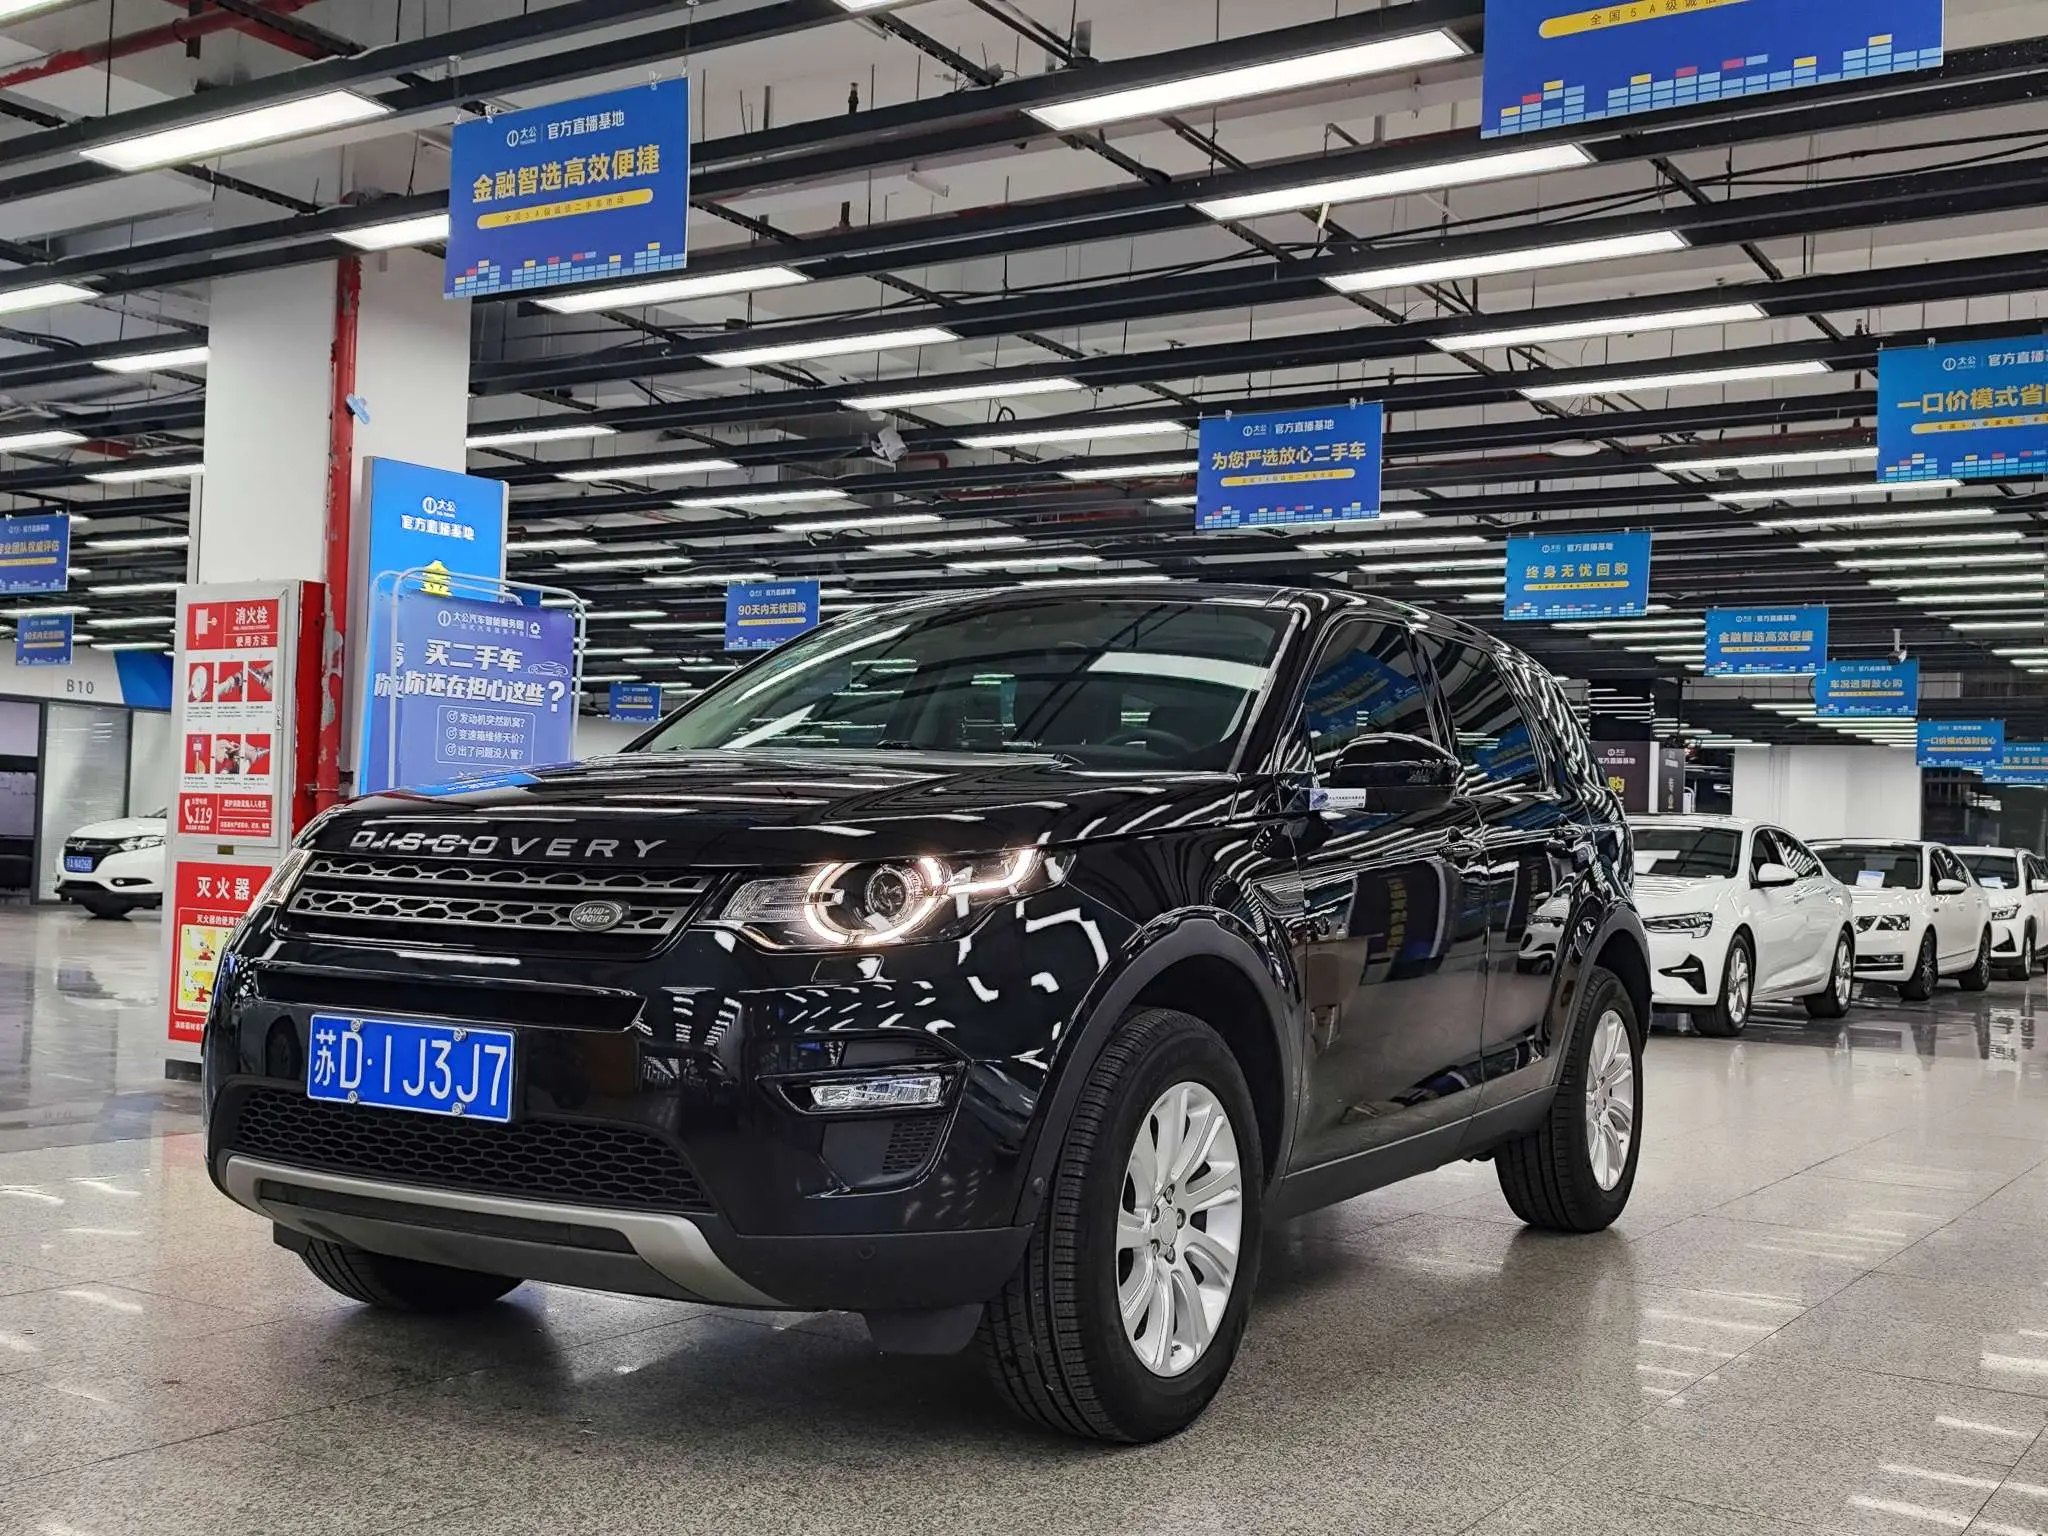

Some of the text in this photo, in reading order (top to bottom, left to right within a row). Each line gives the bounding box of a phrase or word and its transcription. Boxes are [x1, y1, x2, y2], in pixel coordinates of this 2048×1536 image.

[520, 126, 537, 140] 大公
[547, 110, 625, 140] 官方直播基地
[473, 144, 661, 203] 金融智选高效便捷
[1988, 349, 2048, 367] 官方直播
[1897, 383, 2048, 414] 一口价模式省
[1275, 418, 1335, 435] 官方直播基地
[1212, 440, 1367, 471] 为您严选放心二手车
[1525, 561, 1629, 579] 终身无忧回购
[235, 605, 268, 625] 消火栓
[738, 601, 807, 616] 90天内无忧回购
[236, 634, 269, 648] 使用方法
[425, 638, 524, 673] 买二手车
[66, 679, 95, 695] B10
[405, 670, 566, 712] 你还在担心这些?
[459, 713, 526, 728] 发动机突然趴窝?
[458, 729, 525, 744] 变速箱维修天价?
[457, 745, 525, 761] 出了问题没人管?
[193, 806, 213, 825] 119
[350, 830, 667, 858] DISCOVERY
